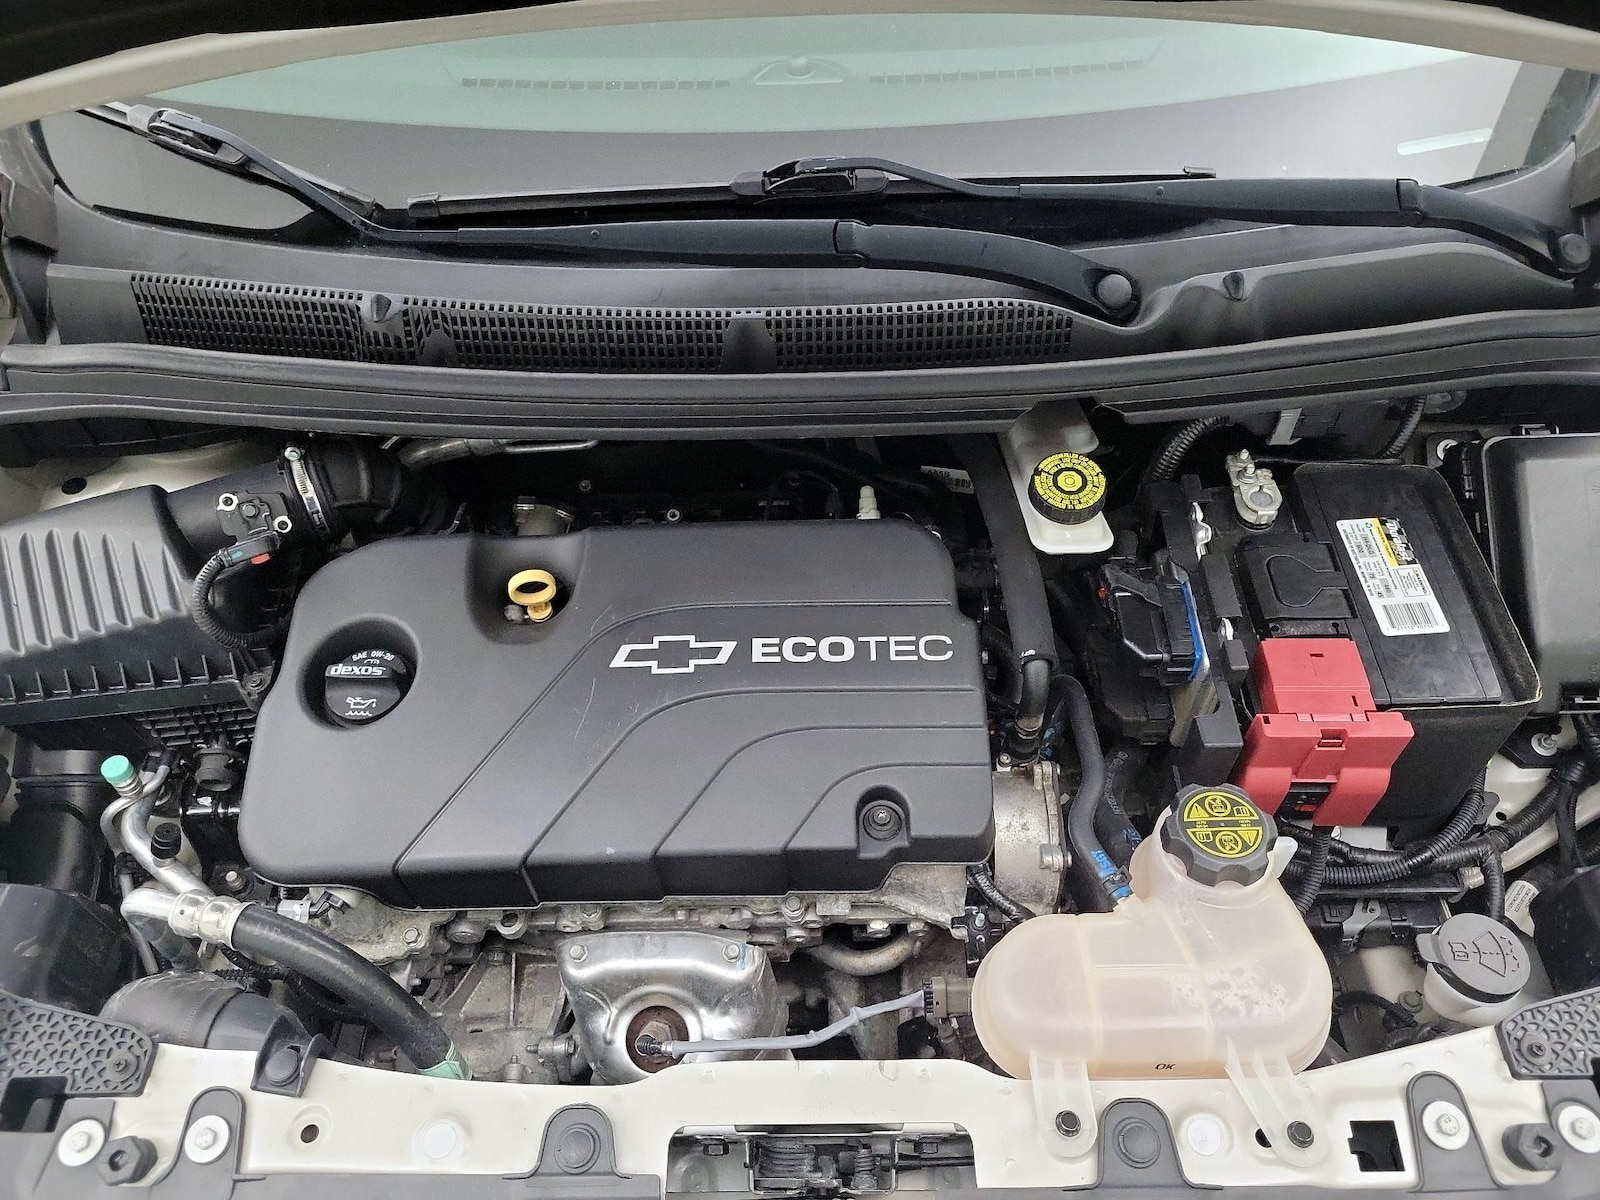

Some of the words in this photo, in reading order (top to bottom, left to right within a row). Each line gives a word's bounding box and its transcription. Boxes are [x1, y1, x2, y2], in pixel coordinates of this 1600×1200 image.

[1386, 521, 1413, 562] Duralast
[352, 651, 367, 661] SAE
[371, 651, 394, 661] 0W-20
[751, 635, 954, 662] ECOTEC
[330, 664, 386, 675] dexos
